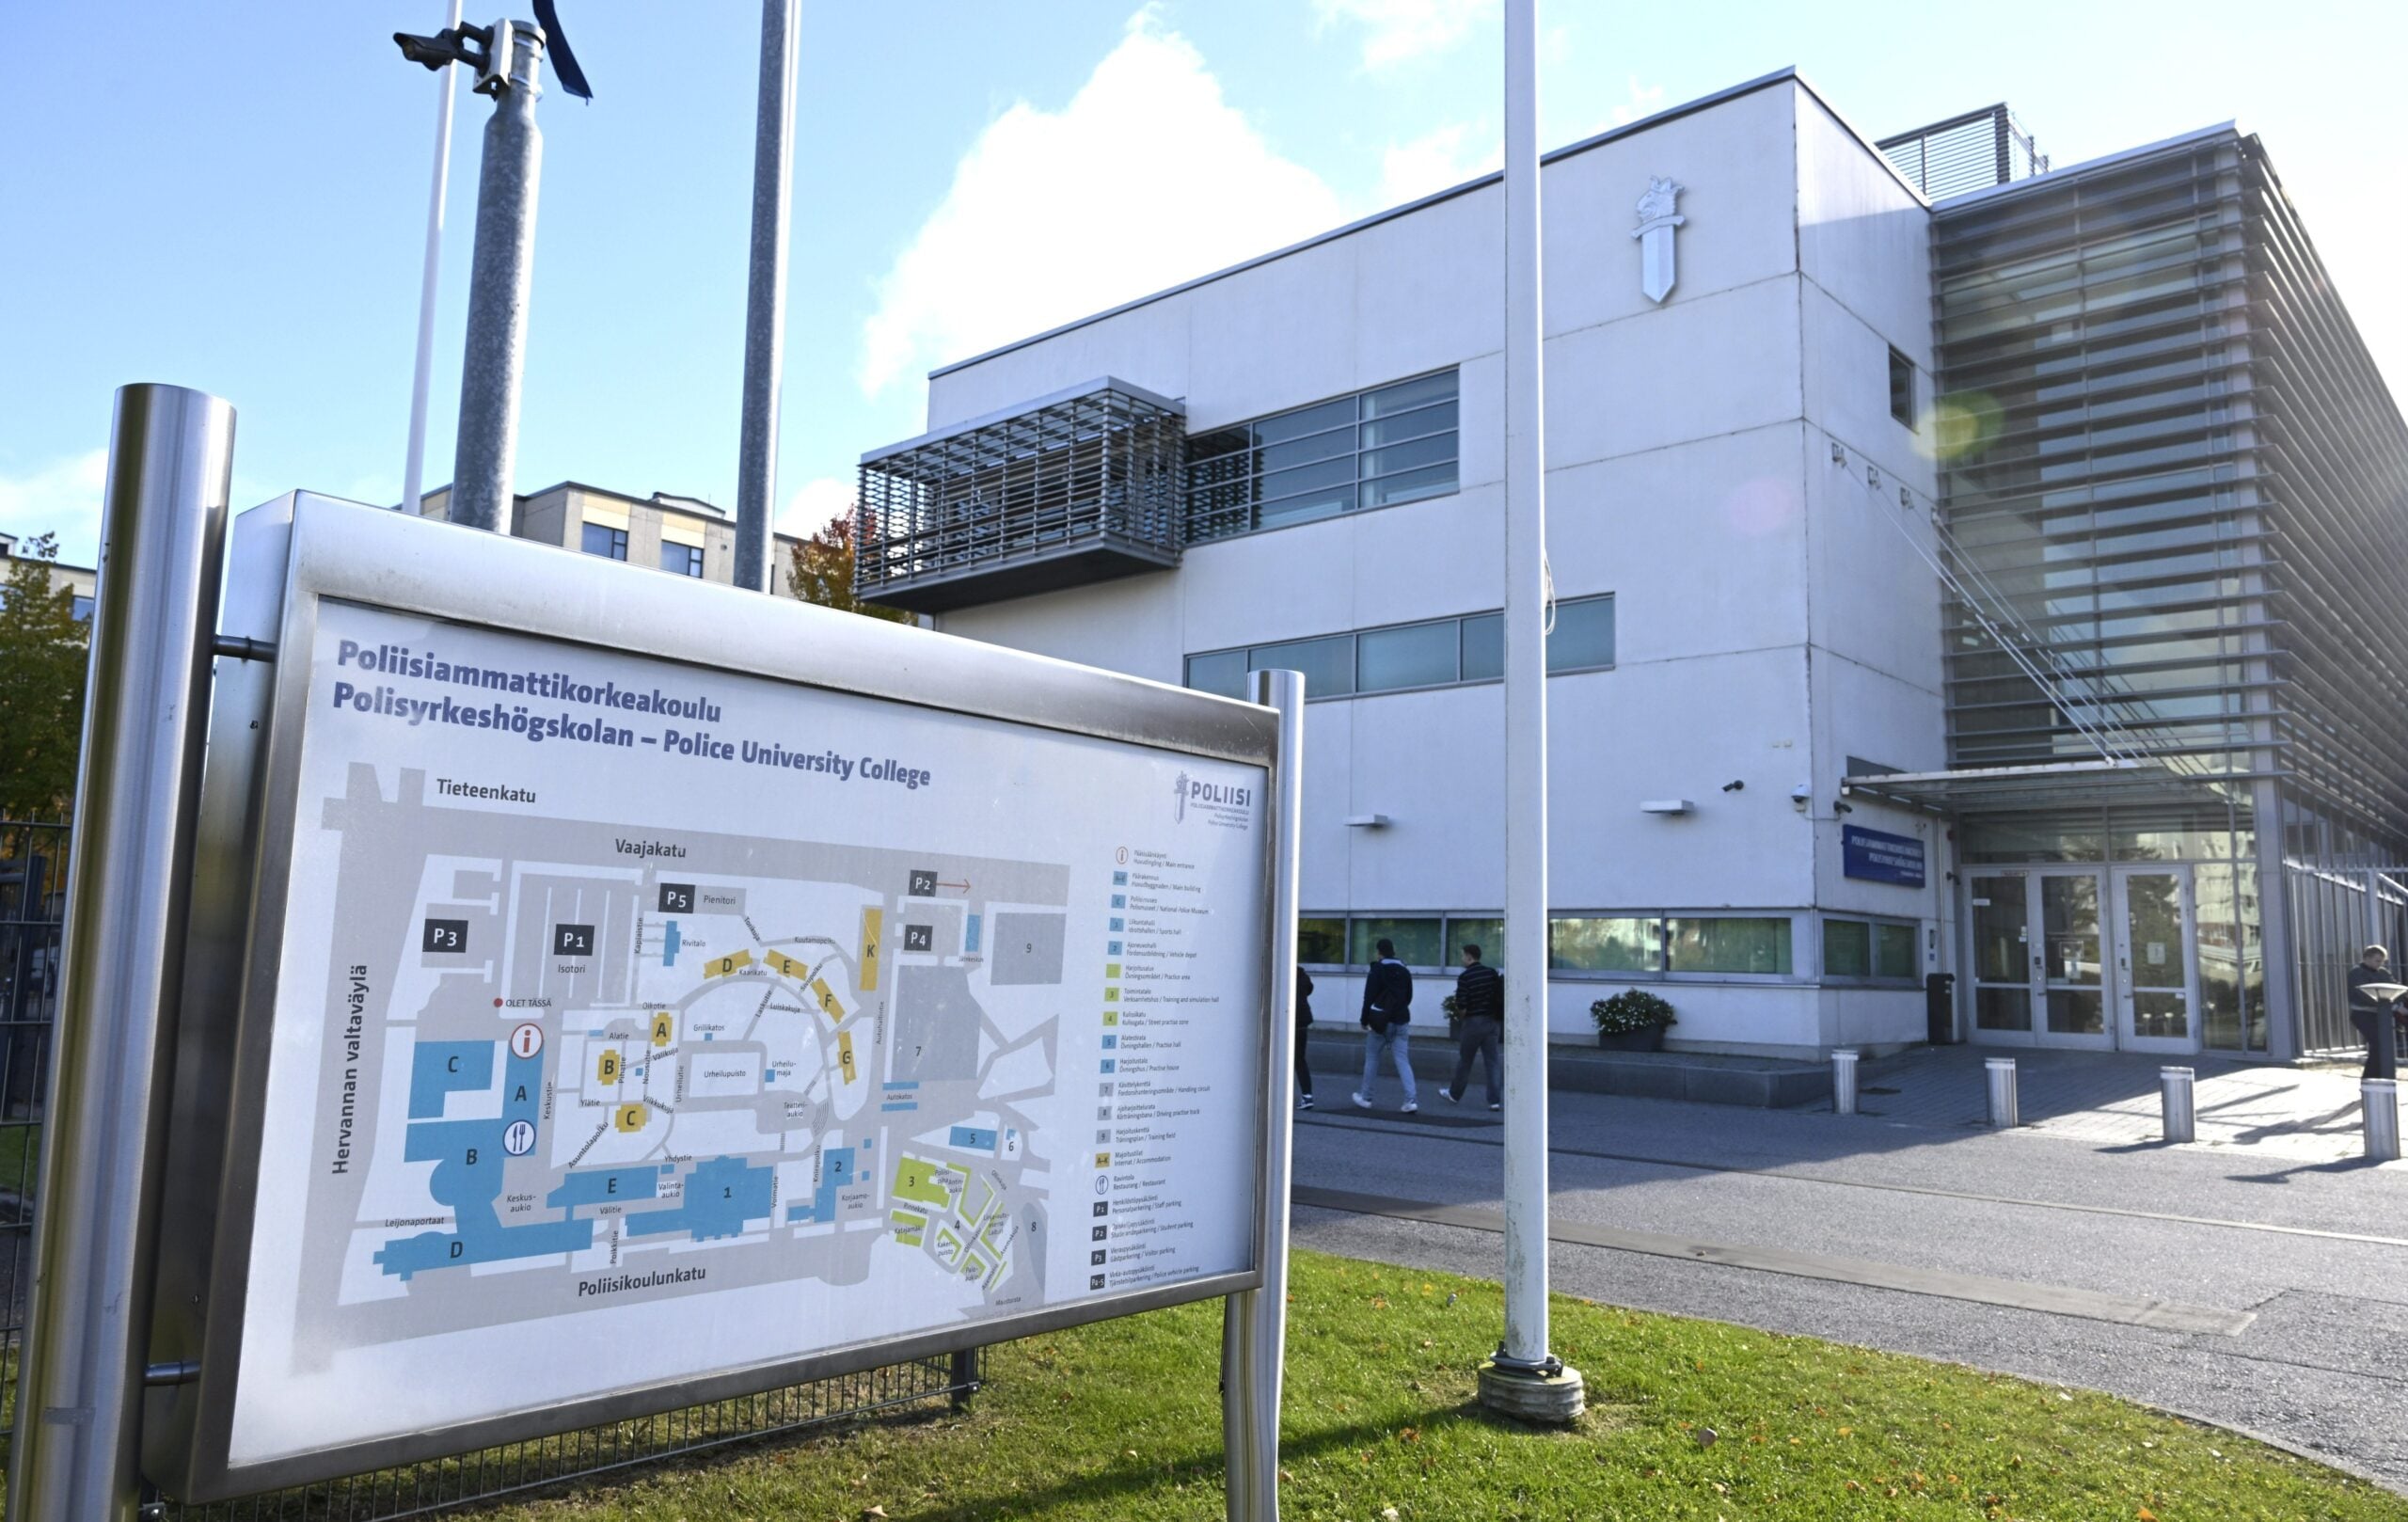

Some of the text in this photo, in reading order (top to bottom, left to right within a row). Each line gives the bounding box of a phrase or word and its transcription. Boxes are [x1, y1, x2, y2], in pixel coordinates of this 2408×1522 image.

[337, 639, 722, 723] Poliisiammattikorkeakoulu
[332, 681, 634, 748] Polisyrkeshögskolan
[663, 729, 735, 760] Police
[741, 739, 854, 781] University
[860, 757, 931, 790] College
[436, 779, 537, 804] Tieteenkatu
[1191, 781, 1251, 807] POLIISI
[614, 839, 687, 859] Vaajakatu
[704, 896, 737, 905] Pienitori
[867, 944, 875, 958] K
[1026, 943, 1032, 953] 9
[558, 963, 587, 975] Isotori
[722, 958, 732, 973] D
[784, 959, 791, 974] E
[505, 998, 552, 1007] OLET TÄSSÄ
[825, 994, 832, 1007] F
[770, 1003, 800, 1014] Luiskakuja
[657, 1023, 667, 1038] A
[693, 1023, 725, 1032] Grillikatos
[843, 1051, 851, 1064] G
[915, 1046, 922, 1056] 7
[332, 965, 370, 1174] Hervannan valtaväylä
[448, 1056, 459, 1072] C
[604, 1059, 614, 1074] B
[618, 1057, 626, 1083] Pihatie
[642, 1050, 651, 1085] Nousutie
[704, 1070, 746, 1078] Urheilupuisto
[776, 1069, 791, 1077] maja
[675, 1066, 684, 1102] Urheilutie
[515, 1086, 527, 1102] A
[626, 1111, 636, 1126] C
[568, 1120, 610, 1168] Asuntolapolku
[970, 1134, 975, 1144] 5
[1008, 1142, 1014, 1151] 6
[466, 1149, 477, 1165] B
[665, 1154, 692, 1163] Yhdystie
[834, 1161, 842, 1172] 2
[608, 1178, 617, 1194] E
[658, 1182, 684, 1191] Valinta-
[909, 1177, 914, 1187] 3
[506, 1194, 537, 1202] Keskus-
[724, 1187, 732, 1198] 1
[510, 1203, 531, 1213] aukio
[599, 1207, 622, 1215] Välitie
[903, 1202, 928, 1214] Rinnekatu
[385, 1215, 444, 1229] Leijonaportaat
[955, 1220, 960, 1229] 4
[1031, 1222, 1037, 1231] 8
[450, 1242, 463, 1259] D
[610, 1230, 619, 1264] Poikkitie
[578, 1267, 706, 1297] Poliisikoulunkatu
